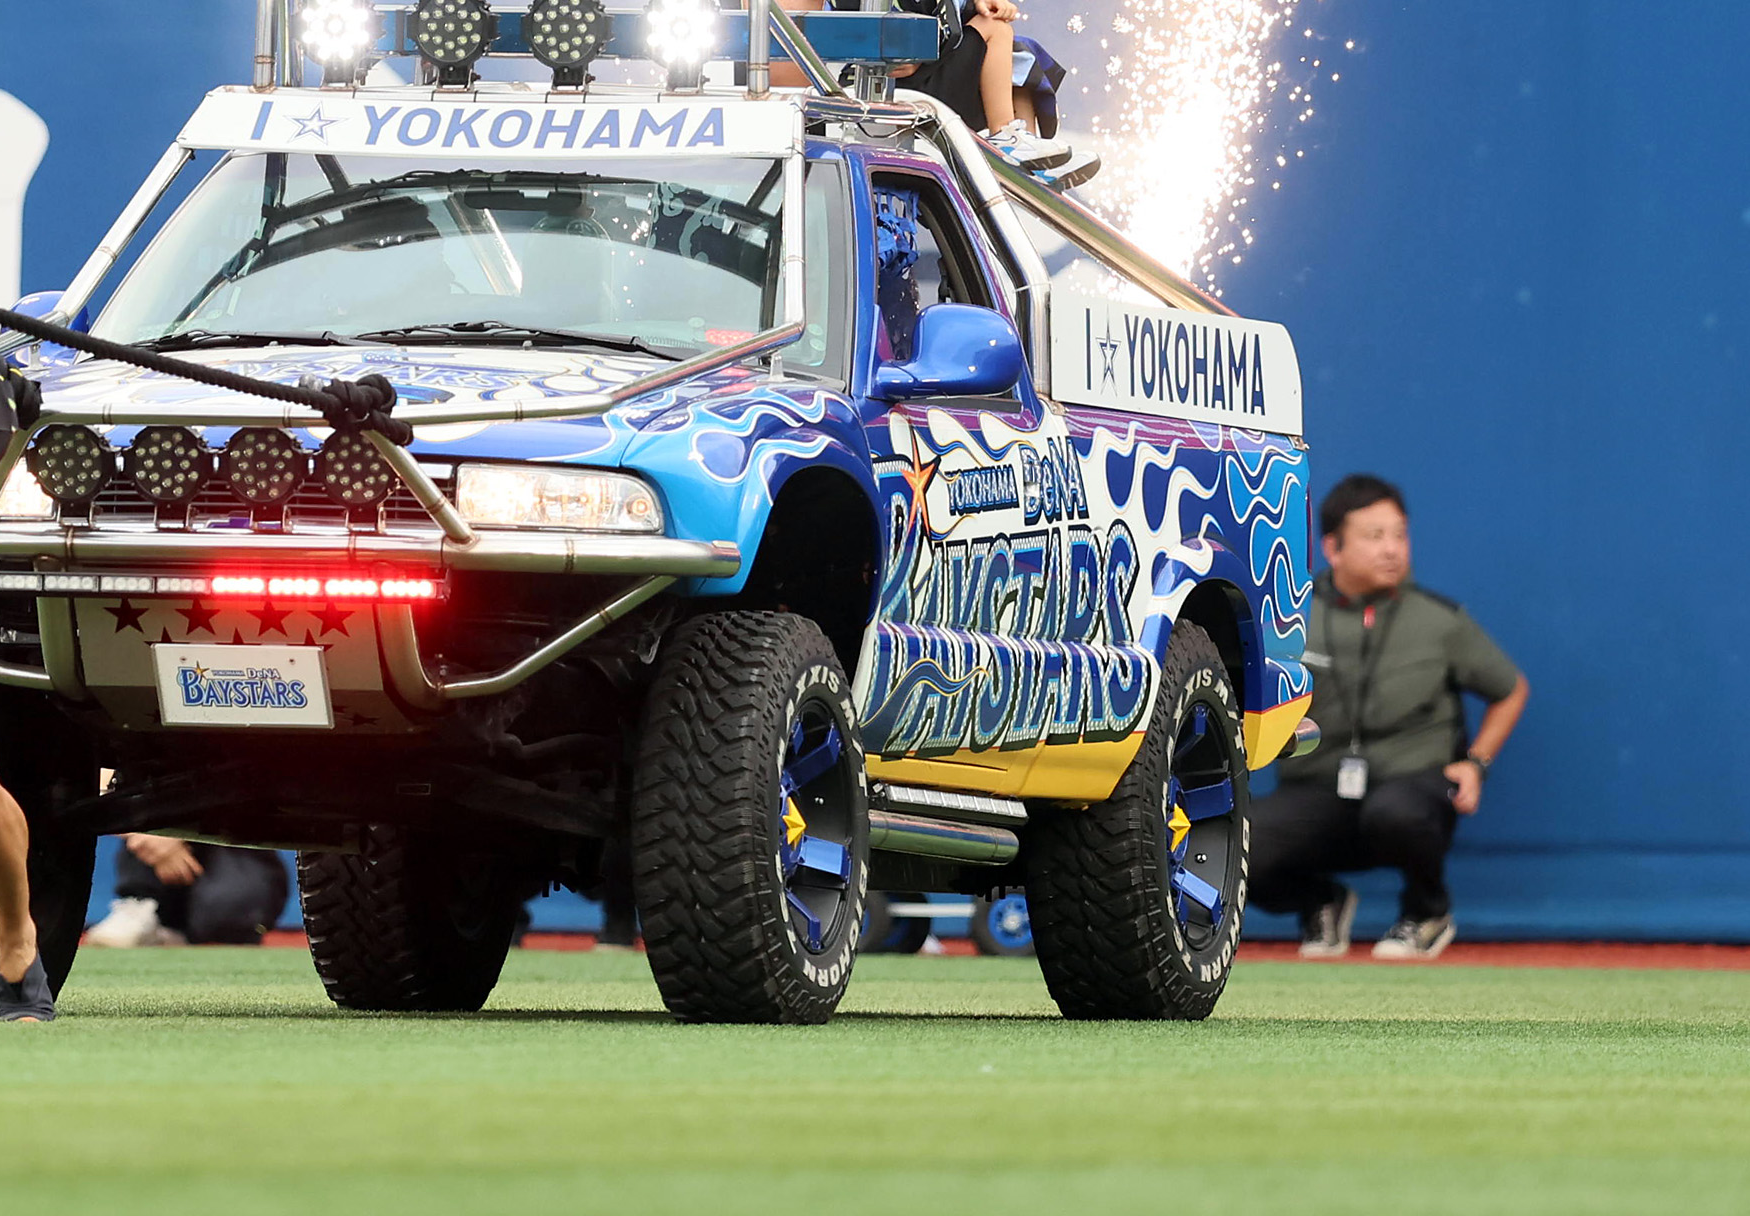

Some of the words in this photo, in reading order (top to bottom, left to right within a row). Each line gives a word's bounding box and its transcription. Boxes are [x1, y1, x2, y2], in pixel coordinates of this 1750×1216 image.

[251, 100, 274, 141] I
[364, 105, 725, 149] YOKOHAMA
[1085, 307, 1092, 391] I
[1124, 313, 1266, 417] YOKOHAMA
[945, 463, 1020, 516] YOKOHAMA
[1018, 435, 1090, 527] DeNA
[177, 666, 308, 708] BAYSTARS
[246, 667, 281, 681] DeNA
